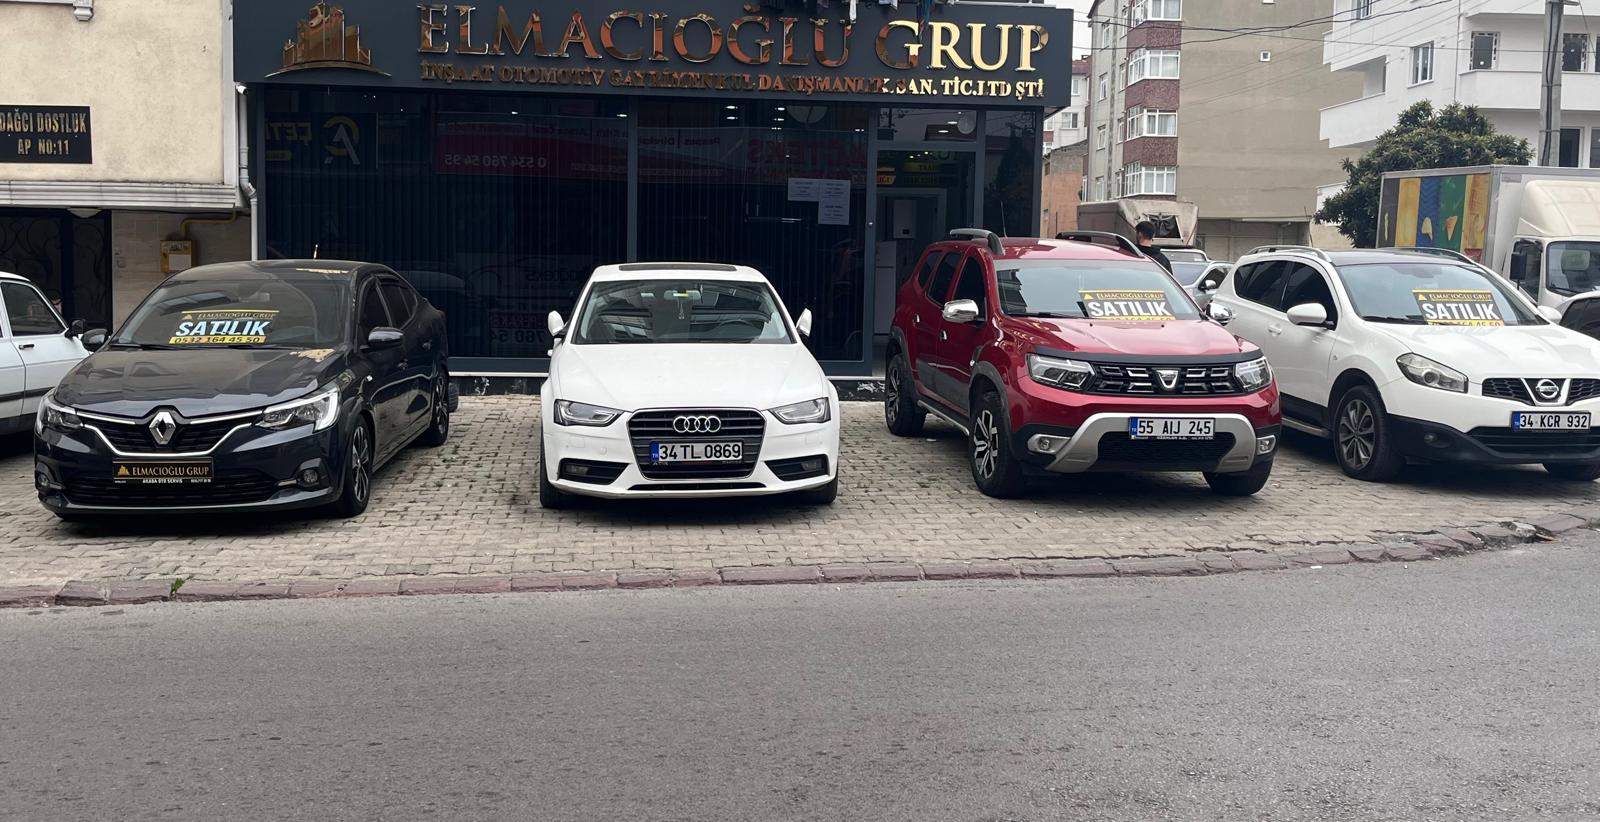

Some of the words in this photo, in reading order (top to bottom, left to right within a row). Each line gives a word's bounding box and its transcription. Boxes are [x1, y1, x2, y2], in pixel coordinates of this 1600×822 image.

[416, 2, 856, 68] ELMACIOĞLU
[875, 20, 1050, 72] GRUP
[420, 60, 495, 85] İNŞAAT
[499, 65, 606, 87] OTOMOTİV
[36, 112, 87, 133] DOSTLUK
[17, 138, 32, 155] AP
[38, 138, 70, 155] NO:11
[1087, 301, 1172, 316] SATILIK
[1422, 303, 1500, 320] SATILIK
[175, 320, 270, 336] SATILIK
[1138, 420, 1154, 434] 55
[1162, 420, 1181, 434] AIJ
[1188, 421, 1211, 434] 245
[1520, 415, 1534, 427] 34
[1540, 415, 1561, 428] KCR
[1567, 415, 1588, 427] 932
[659, 445, 677, 460] 34
[680, 444, 702, 459] TL
[704, 443, 741, 459] 0869
[132, 466, 185, 476] ELMACIOĞLU
[186, 467, 209, 476] GRUP
